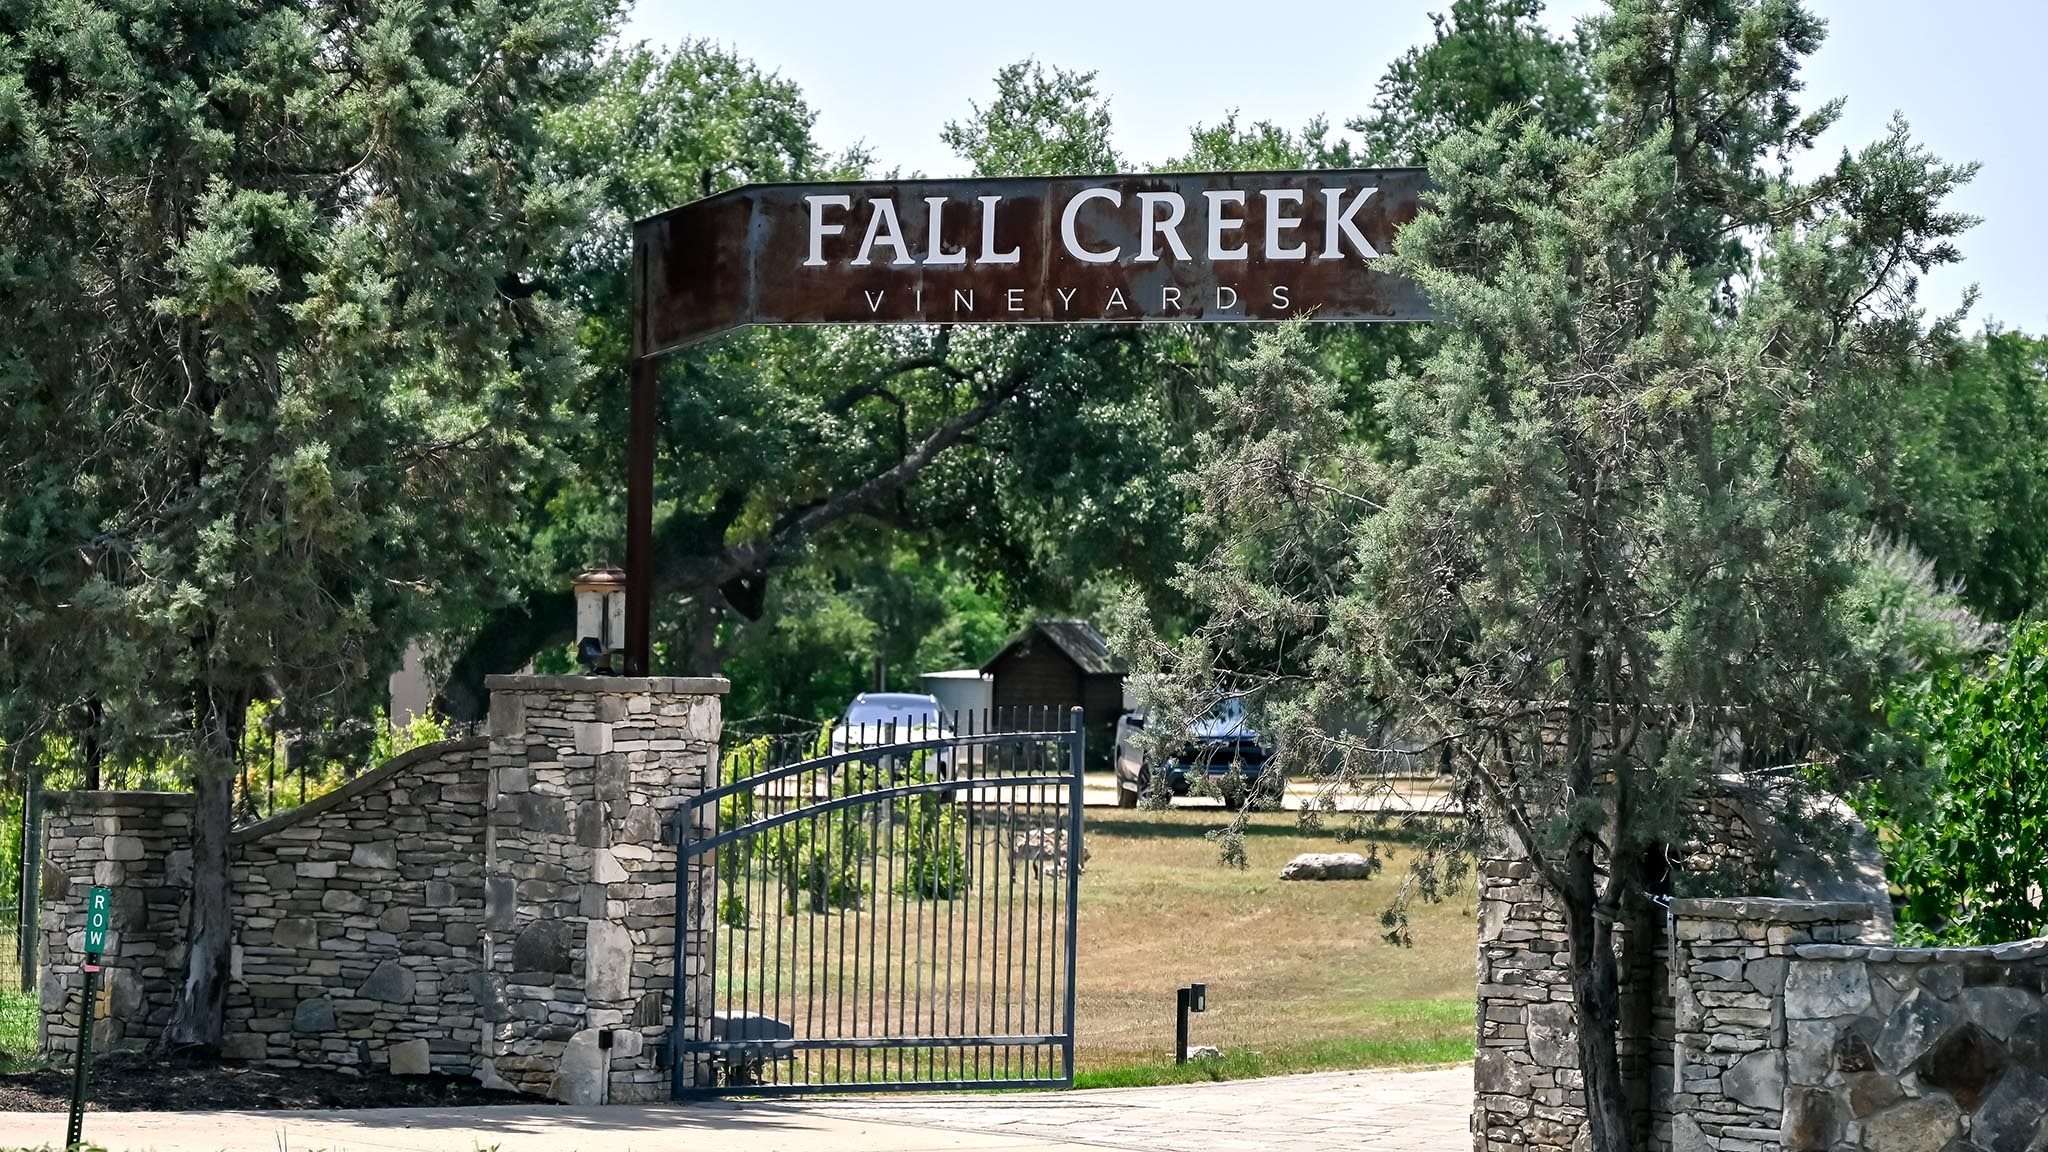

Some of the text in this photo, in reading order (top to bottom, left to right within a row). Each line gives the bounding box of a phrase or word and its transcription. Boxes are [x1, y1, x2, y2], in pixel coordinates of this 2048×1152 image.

[803, 187, 1381, 266] FALL CREEK
[864, 285, 1291, 312] VINEYARDS
[90, 894, 105, 946] ROW
